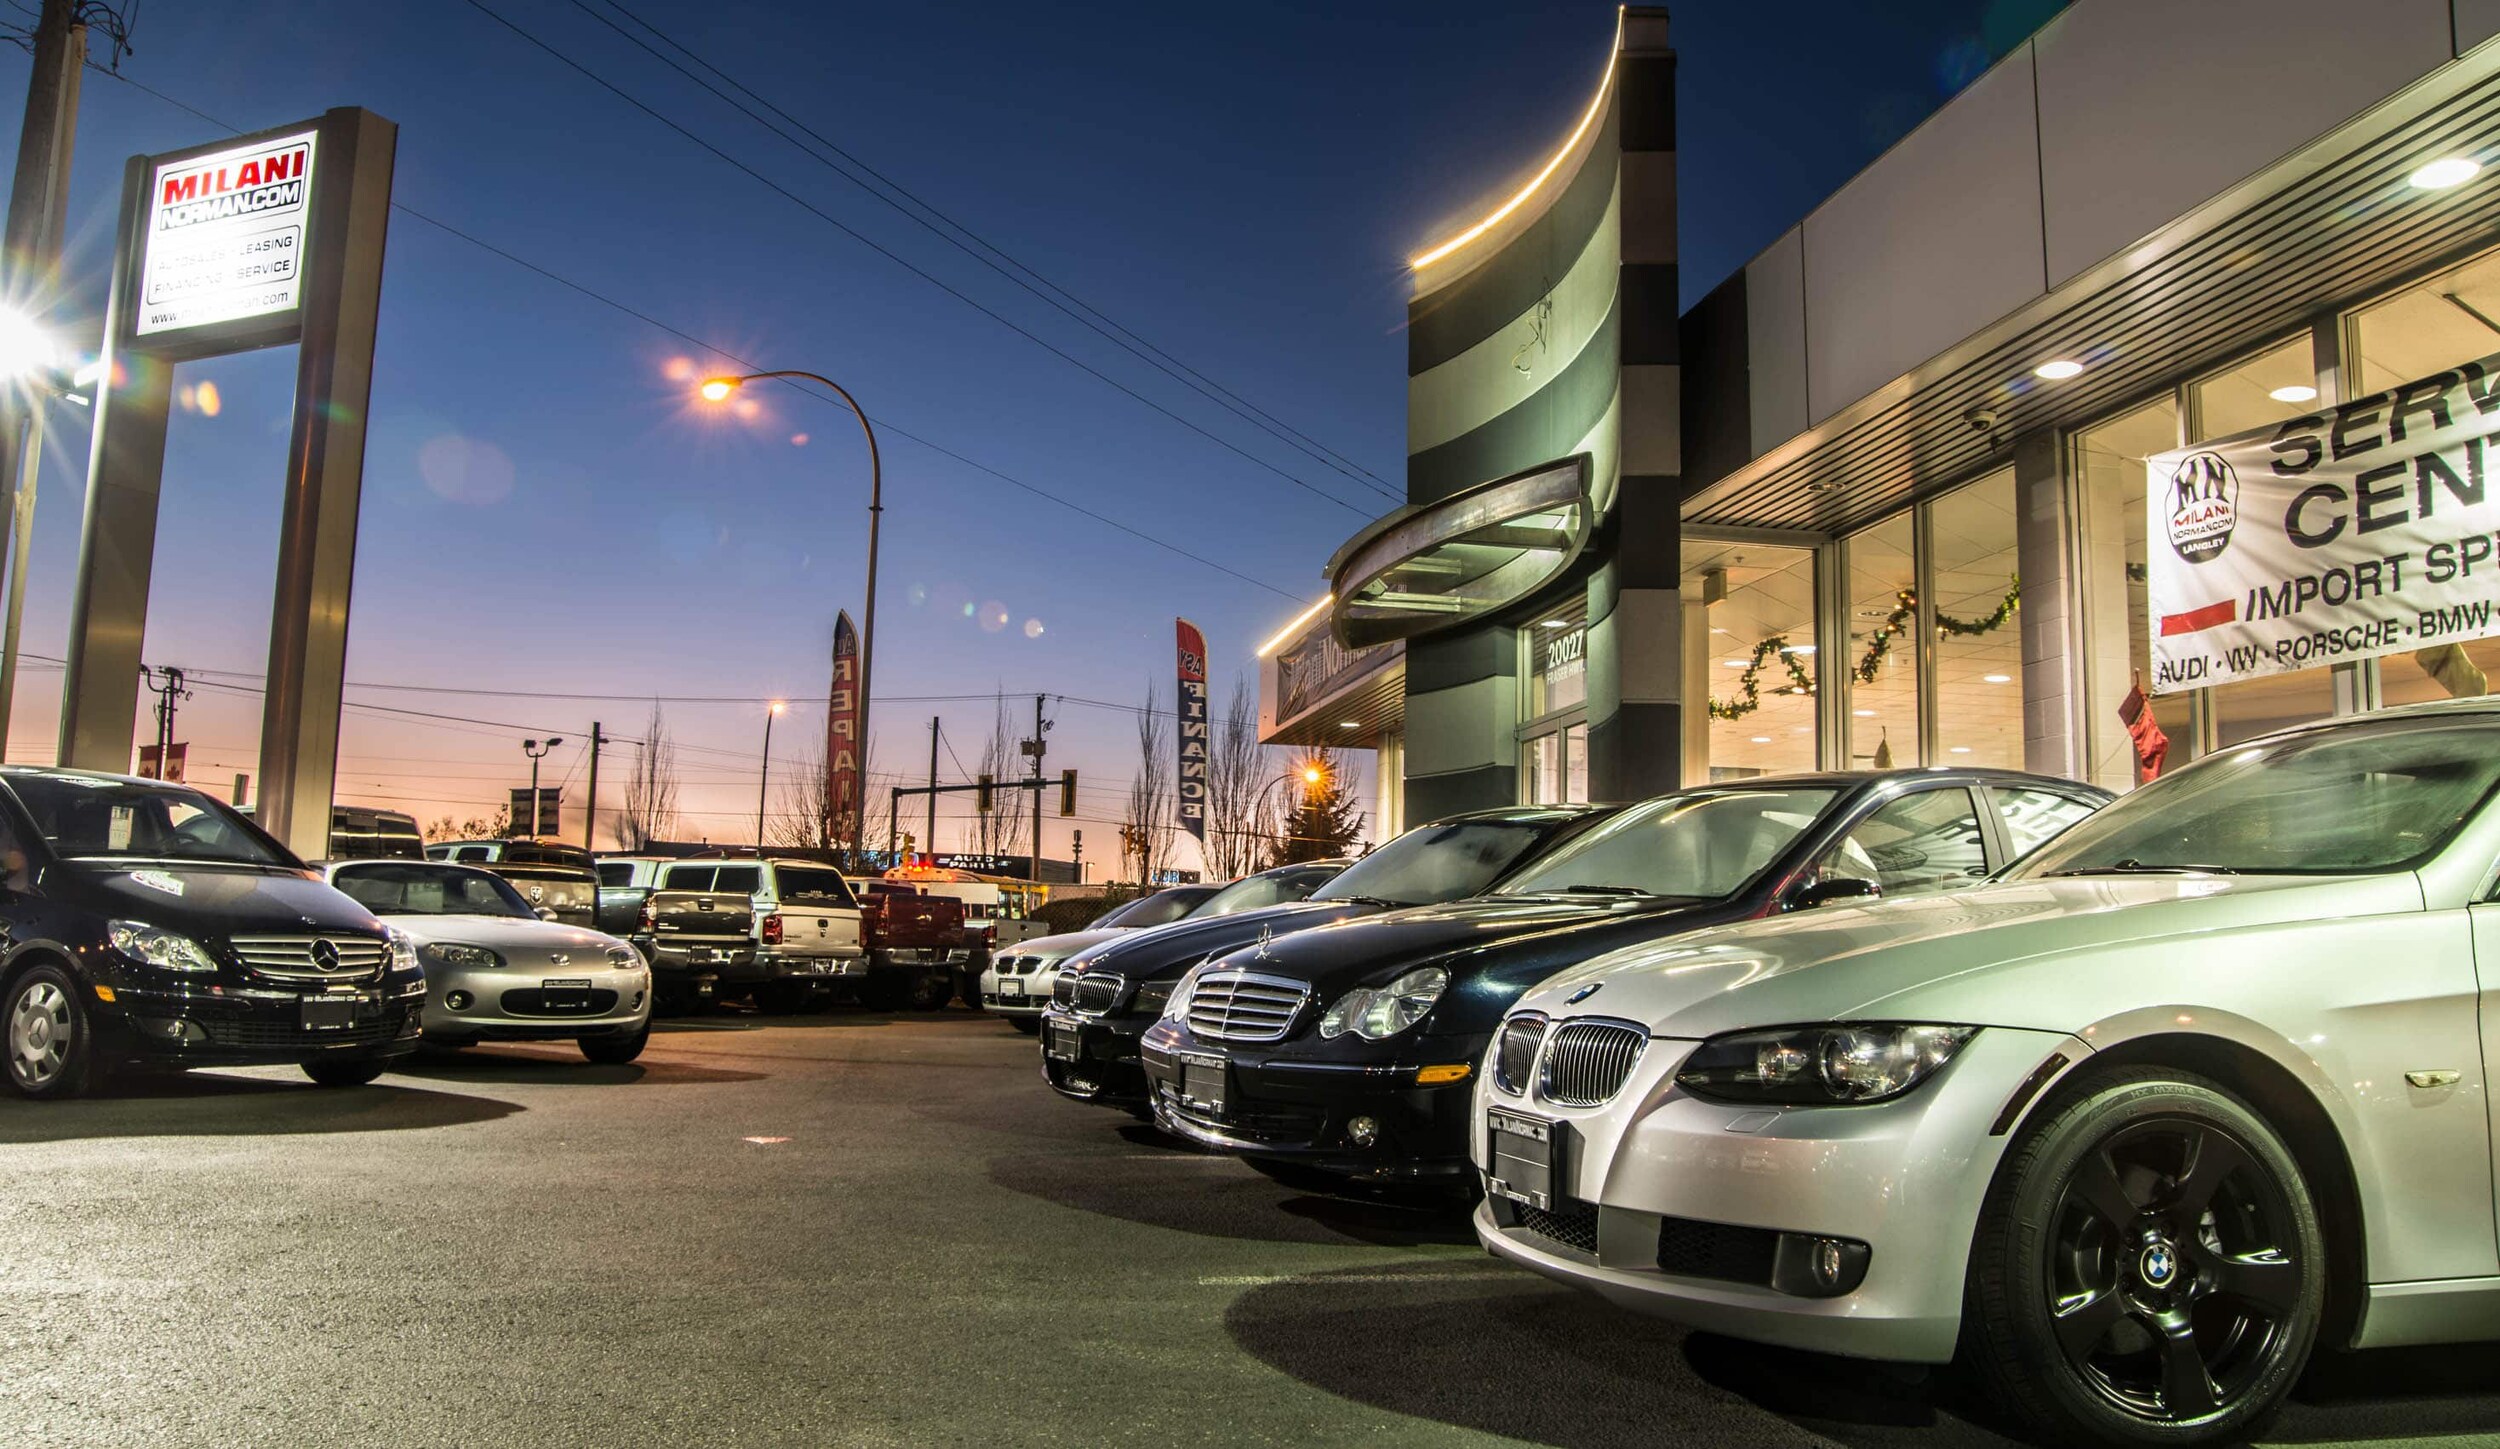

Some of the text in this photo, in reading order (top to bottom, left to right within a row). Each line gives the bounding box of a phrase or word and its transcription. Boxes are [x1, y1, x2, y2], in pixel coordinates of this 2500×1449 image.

[163, 150, 305, 205] MILANI
[160, 180, 302, 231] NORMAN.COM
[240, 236, 293, 256] LEASING
[155, 260, 291, 294] FINANCNG SERVICE
[2285, 431, 2500, 549] CEN
[2175, 505, 2230, 527] MILANI
[2182, 537, 2225, 555] LANGLEY
[2245, 530, 2500, 622] IMPORT SP
[1548, 629, 1584, 669] 20027
[2158, 599, 2491, 685] AUDI VW PORSCHE BMW
[948, 861, 996, 869] PARTS
[953, 854, 994, 862] AUTO
